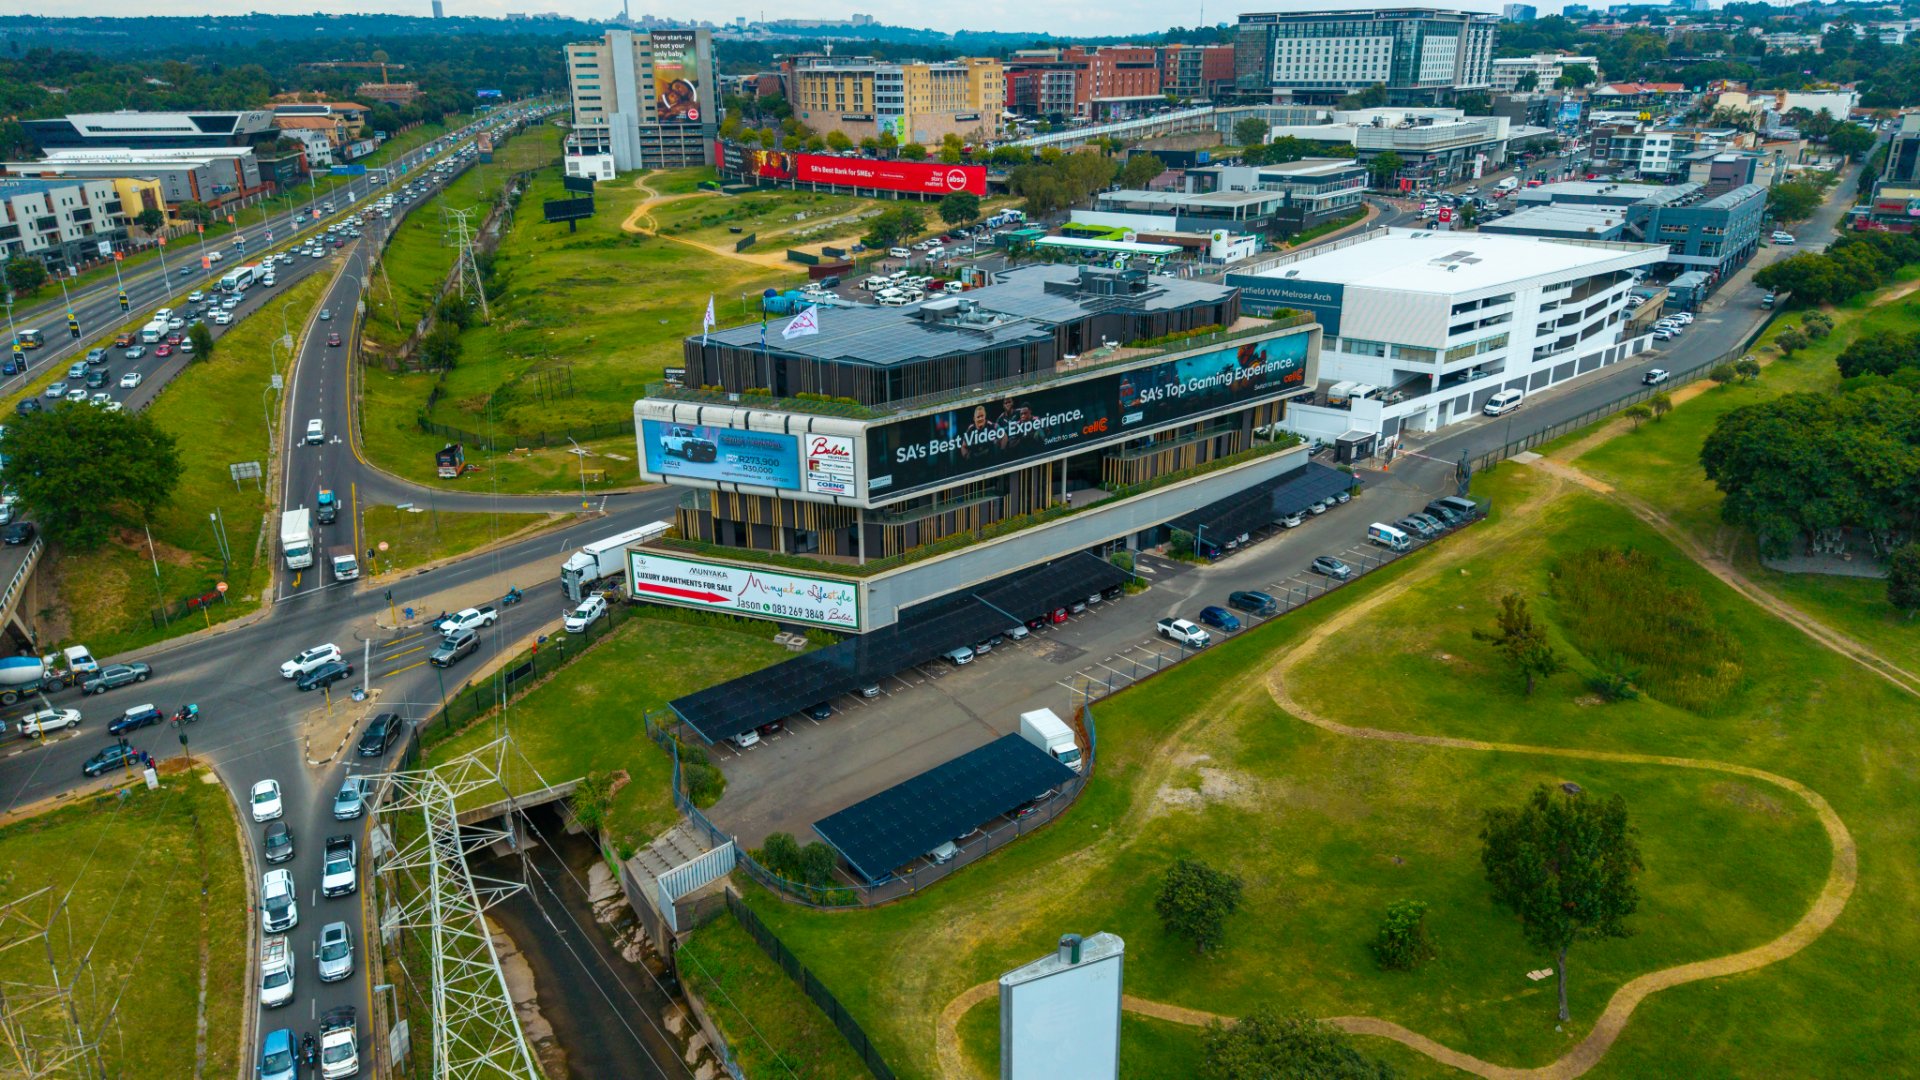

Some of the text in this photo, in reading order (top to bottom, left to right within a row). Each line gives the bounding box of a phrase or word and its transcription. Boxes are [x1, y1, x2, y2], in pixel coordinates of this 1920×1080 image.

[671, 43, 685, 51] your
[654, 50, 667, 58] only
[811, 165, 822, 173] SA's
[822, 166, 834, 174] Best
[834, 167, 848, 175] Bank
[848, 168, 856, 176] for
[1266, 288, 1281, 297] VW
[1281, 290, 1312, 300] Melrose
[1312, 292, 1332, 302] Arch
[1140, 357, 1295, 404] SA's Top Gaming Experience.
[896, 408, 1085, 463] SA's Best Video Experience.
[738, 455, 780, 467] R273,900
[743, 464, 774, 474] R30,000
[689, 567, 728, 579] MUNYAKA
[637, 571, 733, 593] LUXURY APARTMENTS FOR SALE
[737, 572, 853, 607] Munyaka Lifestyle
[736, 596, 825, 621] Jason 083 269 3848
